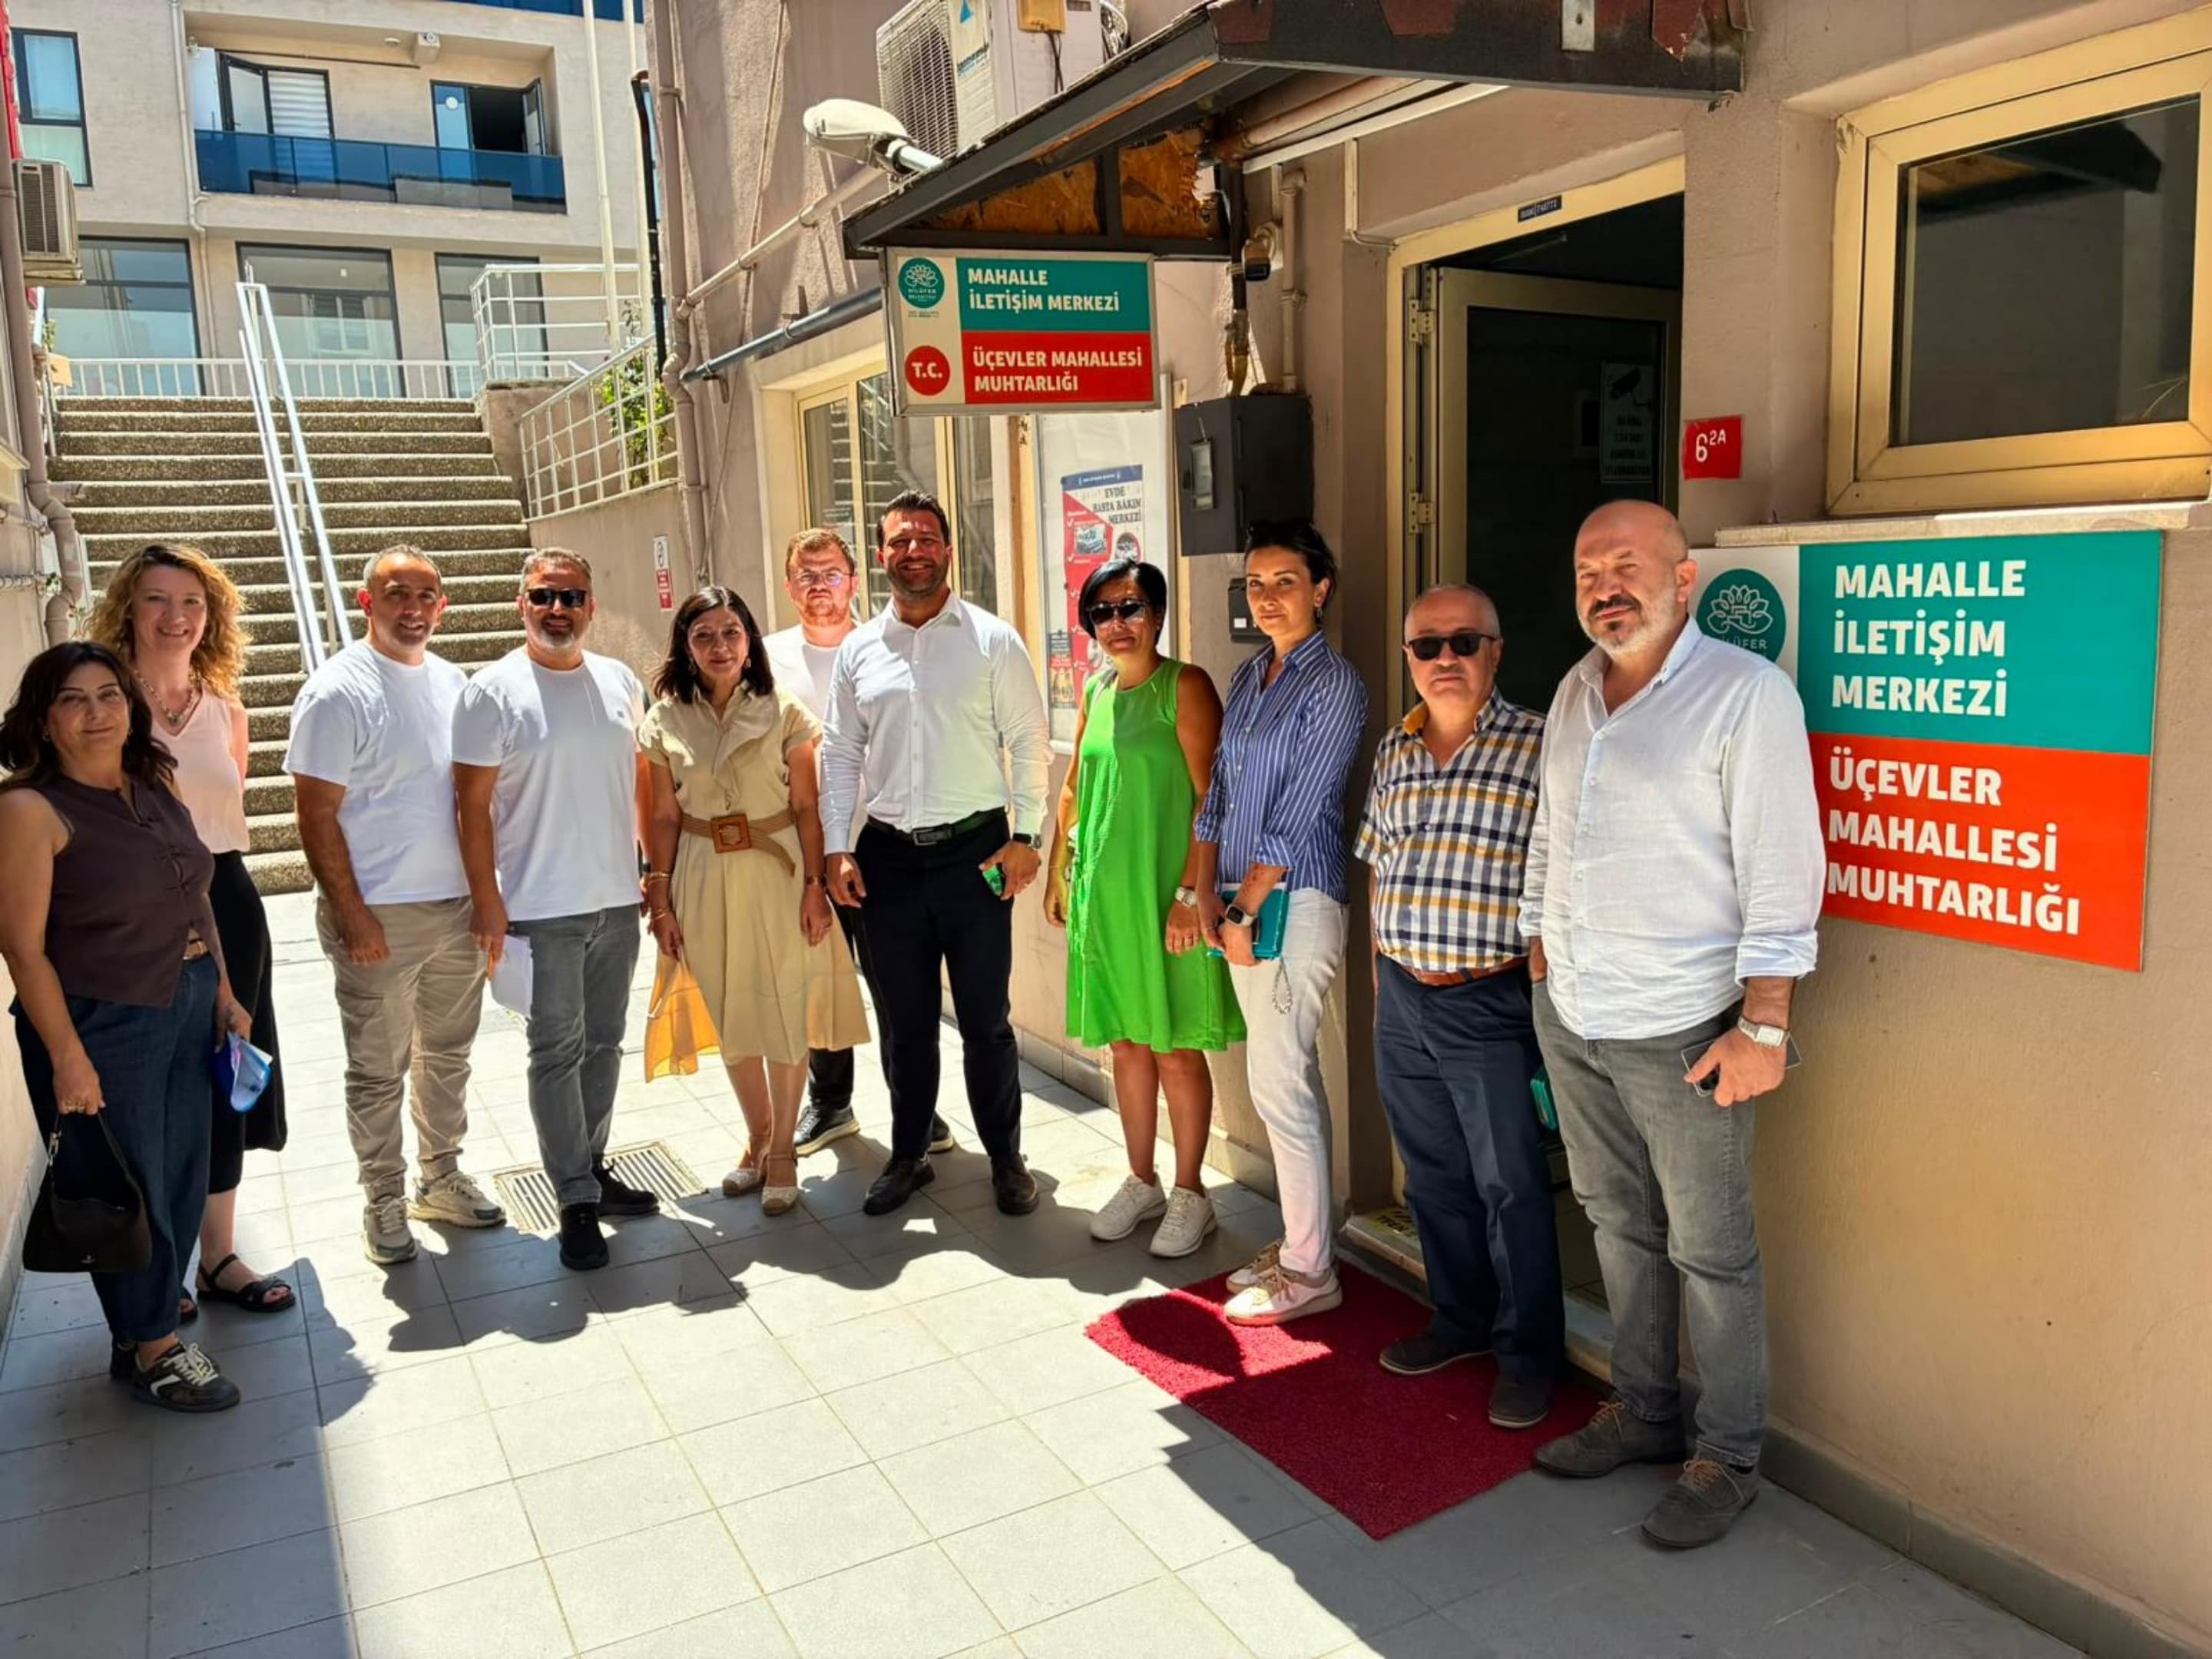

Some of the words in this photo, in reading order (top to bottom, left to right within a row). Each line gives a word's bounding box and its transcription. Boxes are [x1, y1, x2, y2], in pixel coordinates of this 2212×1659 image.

[968, 267, 1048, 286] MAHALLE
[969, 289, 1043, 313] İLETİŞİM
[1048, 291, 1119, 311] MERKEZİ
[912, 363, 943, 379] T.C.
[973, 346, 1047, 371] ÜÇEVLER
[1051, 346, 1142, 367] MAHALLESİ
[975, 372, 1078, 392] MUHTARLIĞI
[1836, 560, 2026, 599] MAHALLE
[1834, 609, 2005, 665] İLETİŞİM
[1833, 669, 2006, 717] MERKEZİ
[1831, 747, 2002, 806] ÜÇEVLER
[1828, 810, 2058, 873] MAHALLESİ
[1827, 863, 2080, 935] MUHTARLIĞI
